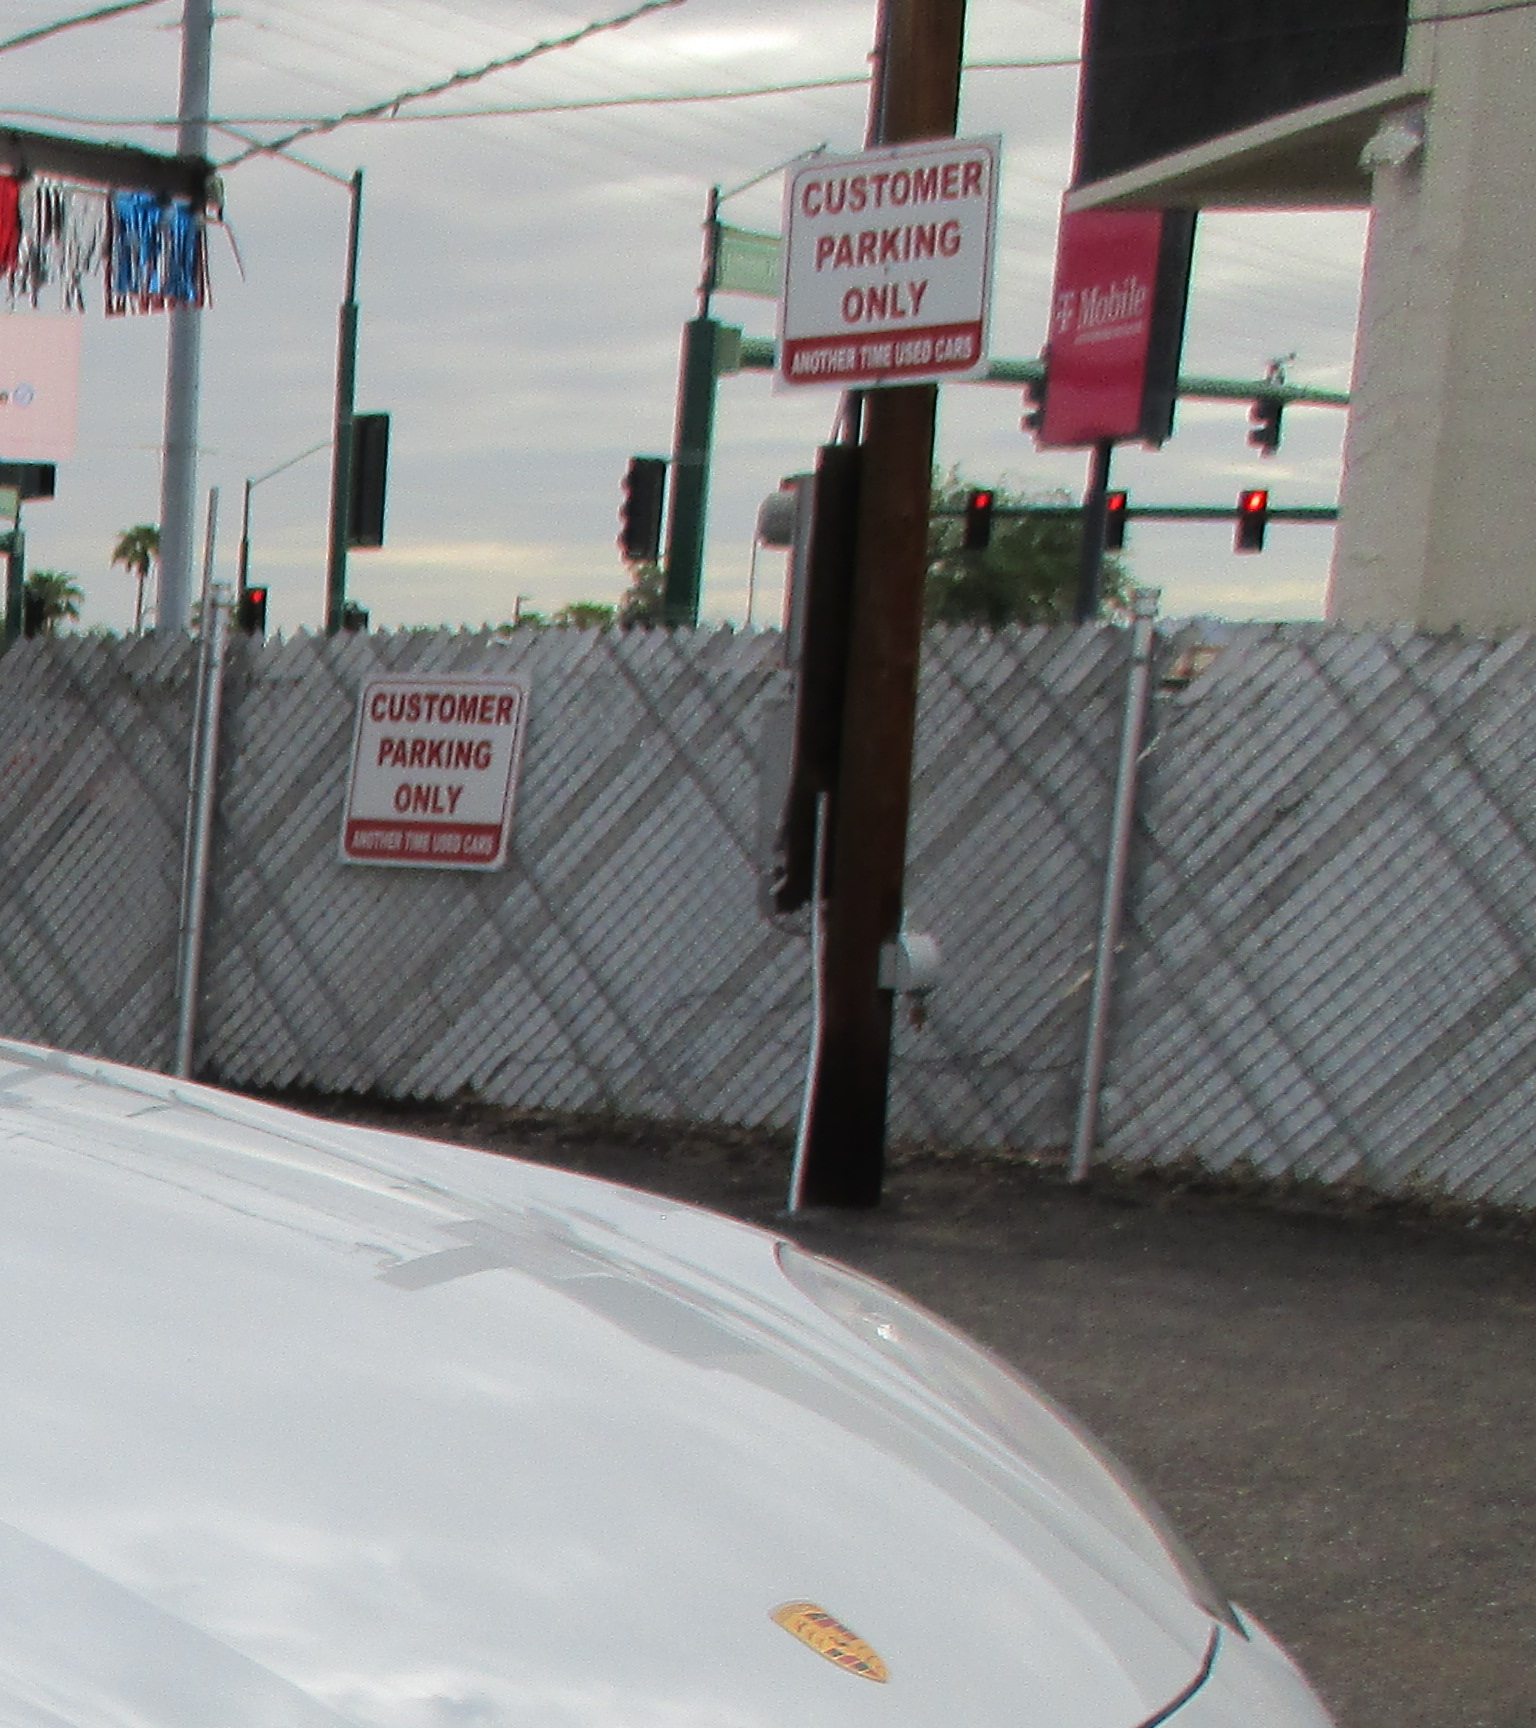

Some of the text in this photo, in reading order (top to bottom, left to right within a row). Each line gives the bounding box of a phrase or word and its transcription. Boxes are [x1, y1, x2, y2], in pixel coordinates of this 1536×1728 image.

[801, 160, 984, 218] CUSTOMER
[815, 220, 962, 273] PARKING
[841, 279, 929, 324] ONLY
[790, 334, 973, 376] ANOTHER TIME USED CARS
[369, 692, 515, 725] CUSTOMER
[377, 737, 494, 771] PARKING
[392, 783, 465, 815] ONLY
